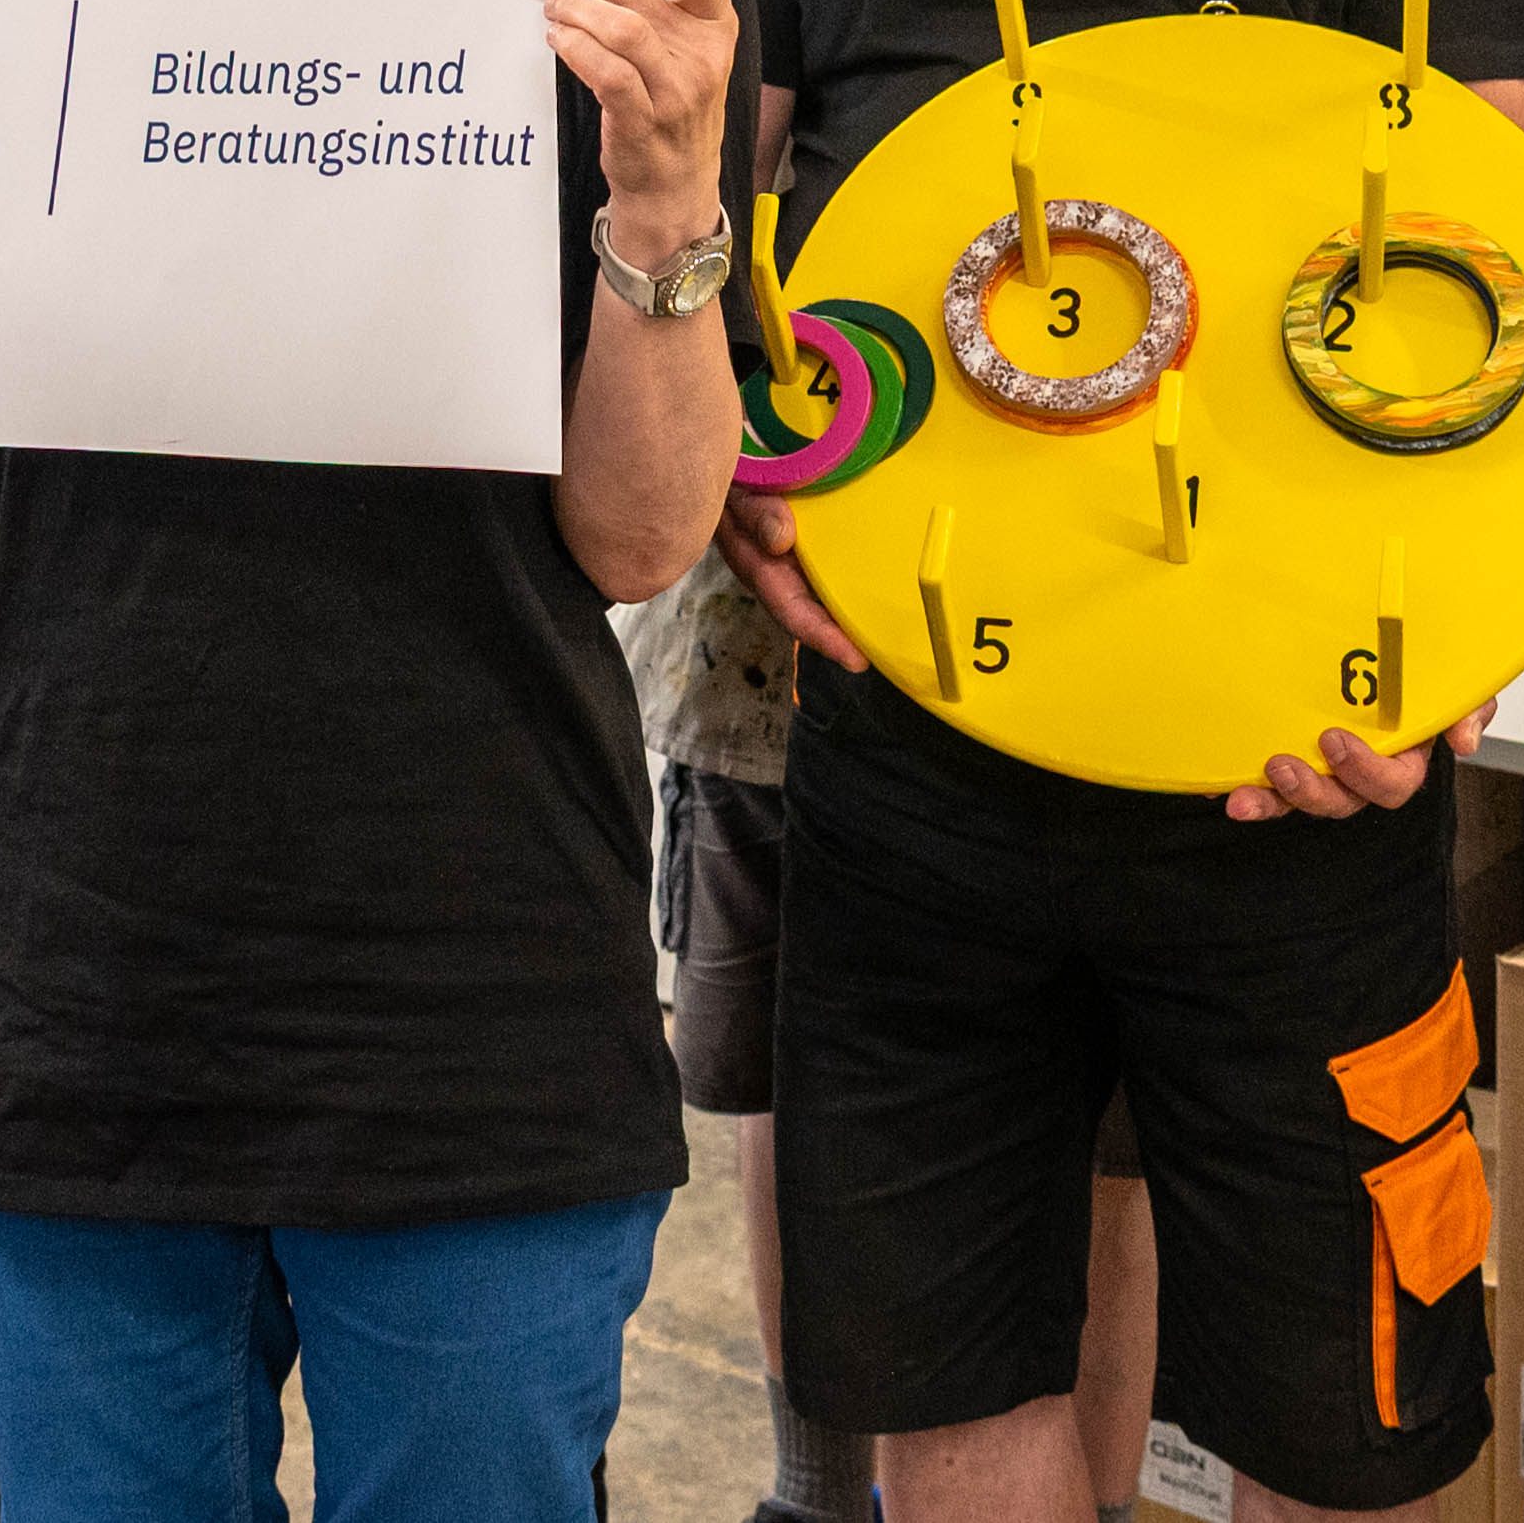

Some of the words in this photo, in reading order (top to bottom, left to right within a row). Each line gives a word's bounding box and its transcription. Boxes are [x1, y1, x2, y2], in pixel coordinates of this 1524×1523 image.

[152, 49, 361, 105] Bildungs-
[380, 49, 466, 95] und
[1379, 83, 1413, 130] 8
[142, 119, 534, 177] Beratungsinstitut
[1047, 288, 1081, 339] 3
[1323, 303, 1356, 353] 2
[1185, 475, 1199, 528] 1
[972, 618, 1012, 674] 5
[1340, 649, 1379, 707] 6
